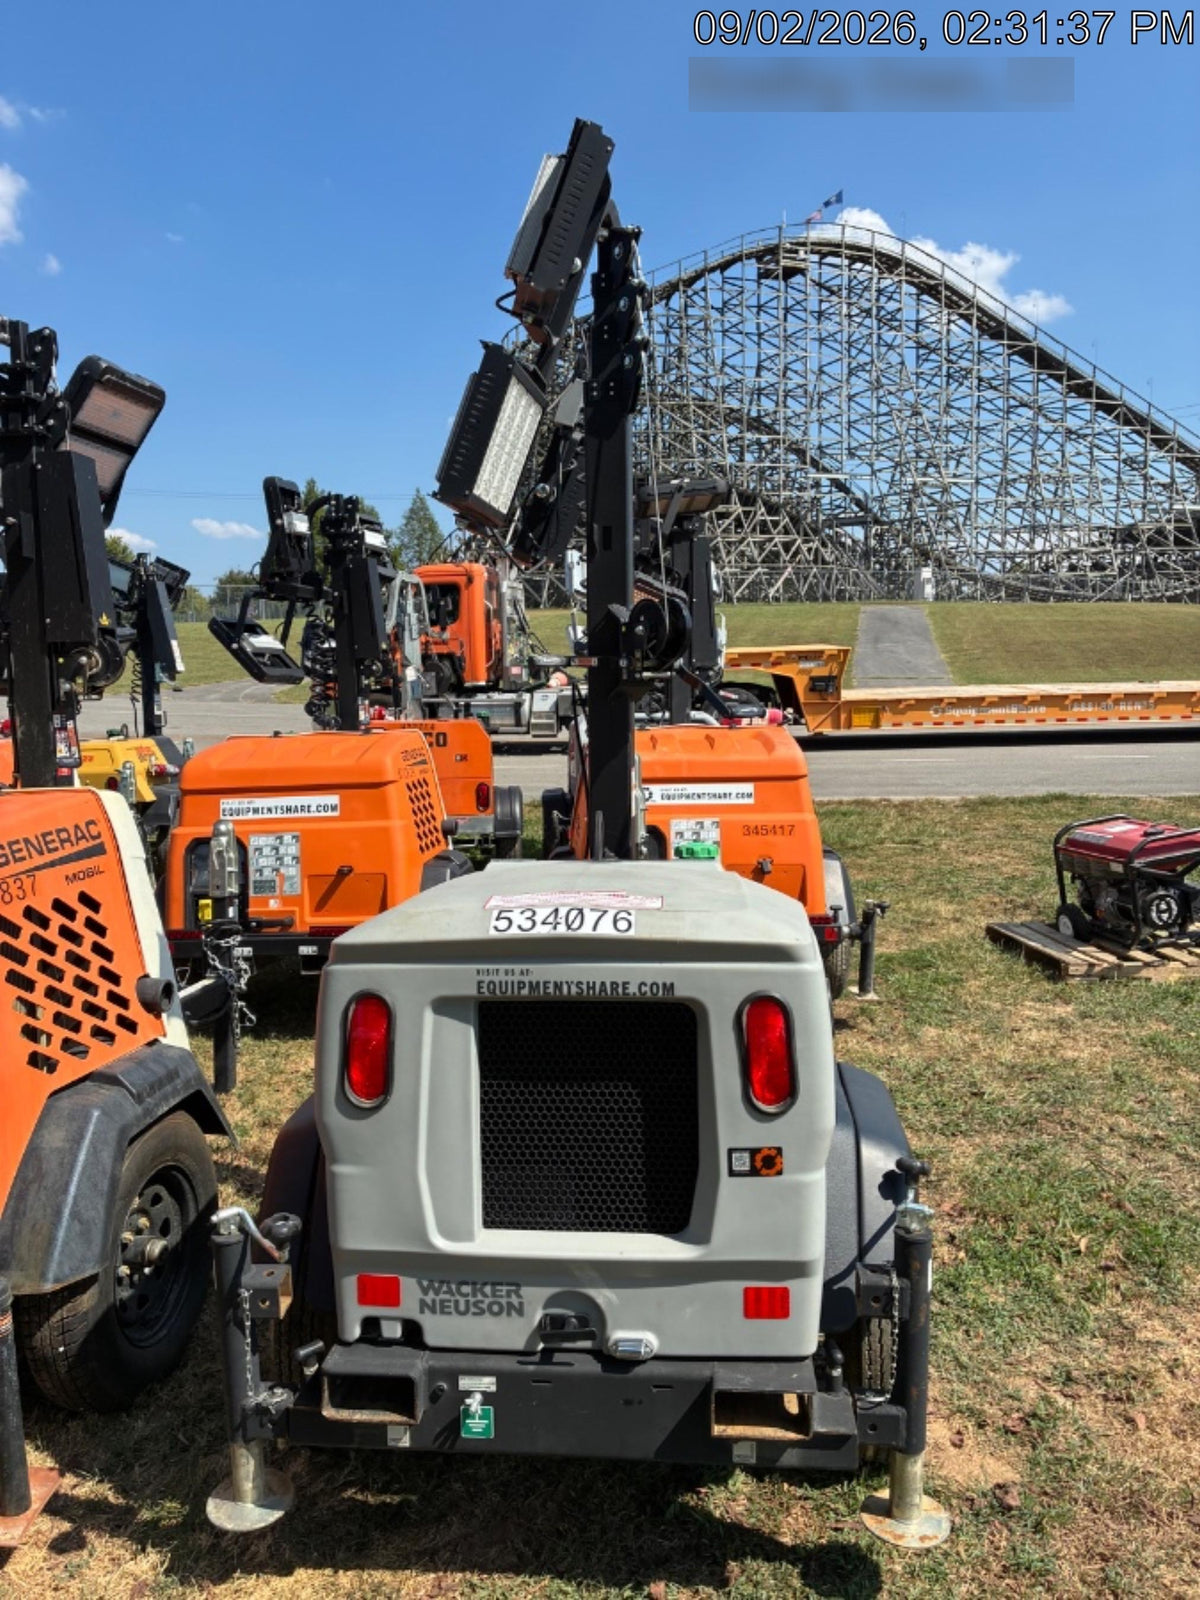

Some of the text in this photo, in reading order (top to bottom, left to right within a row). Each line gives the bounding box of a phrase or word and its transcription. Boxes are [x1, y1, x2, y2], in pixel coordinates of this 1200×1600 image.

[221, 803, 338, 816] EQUIPMENTSHARE.COM
[742, 824, 795, 836] 345417
[493, 907, 632, 933] 534076
[504, 968, 515, 976] US
[477, 980, 675, 996] EQUIPMENTSHARE.COM
[416, 1279, 523, 1298] WACKER
[419, 1298, 524, 1317] NEUSON
